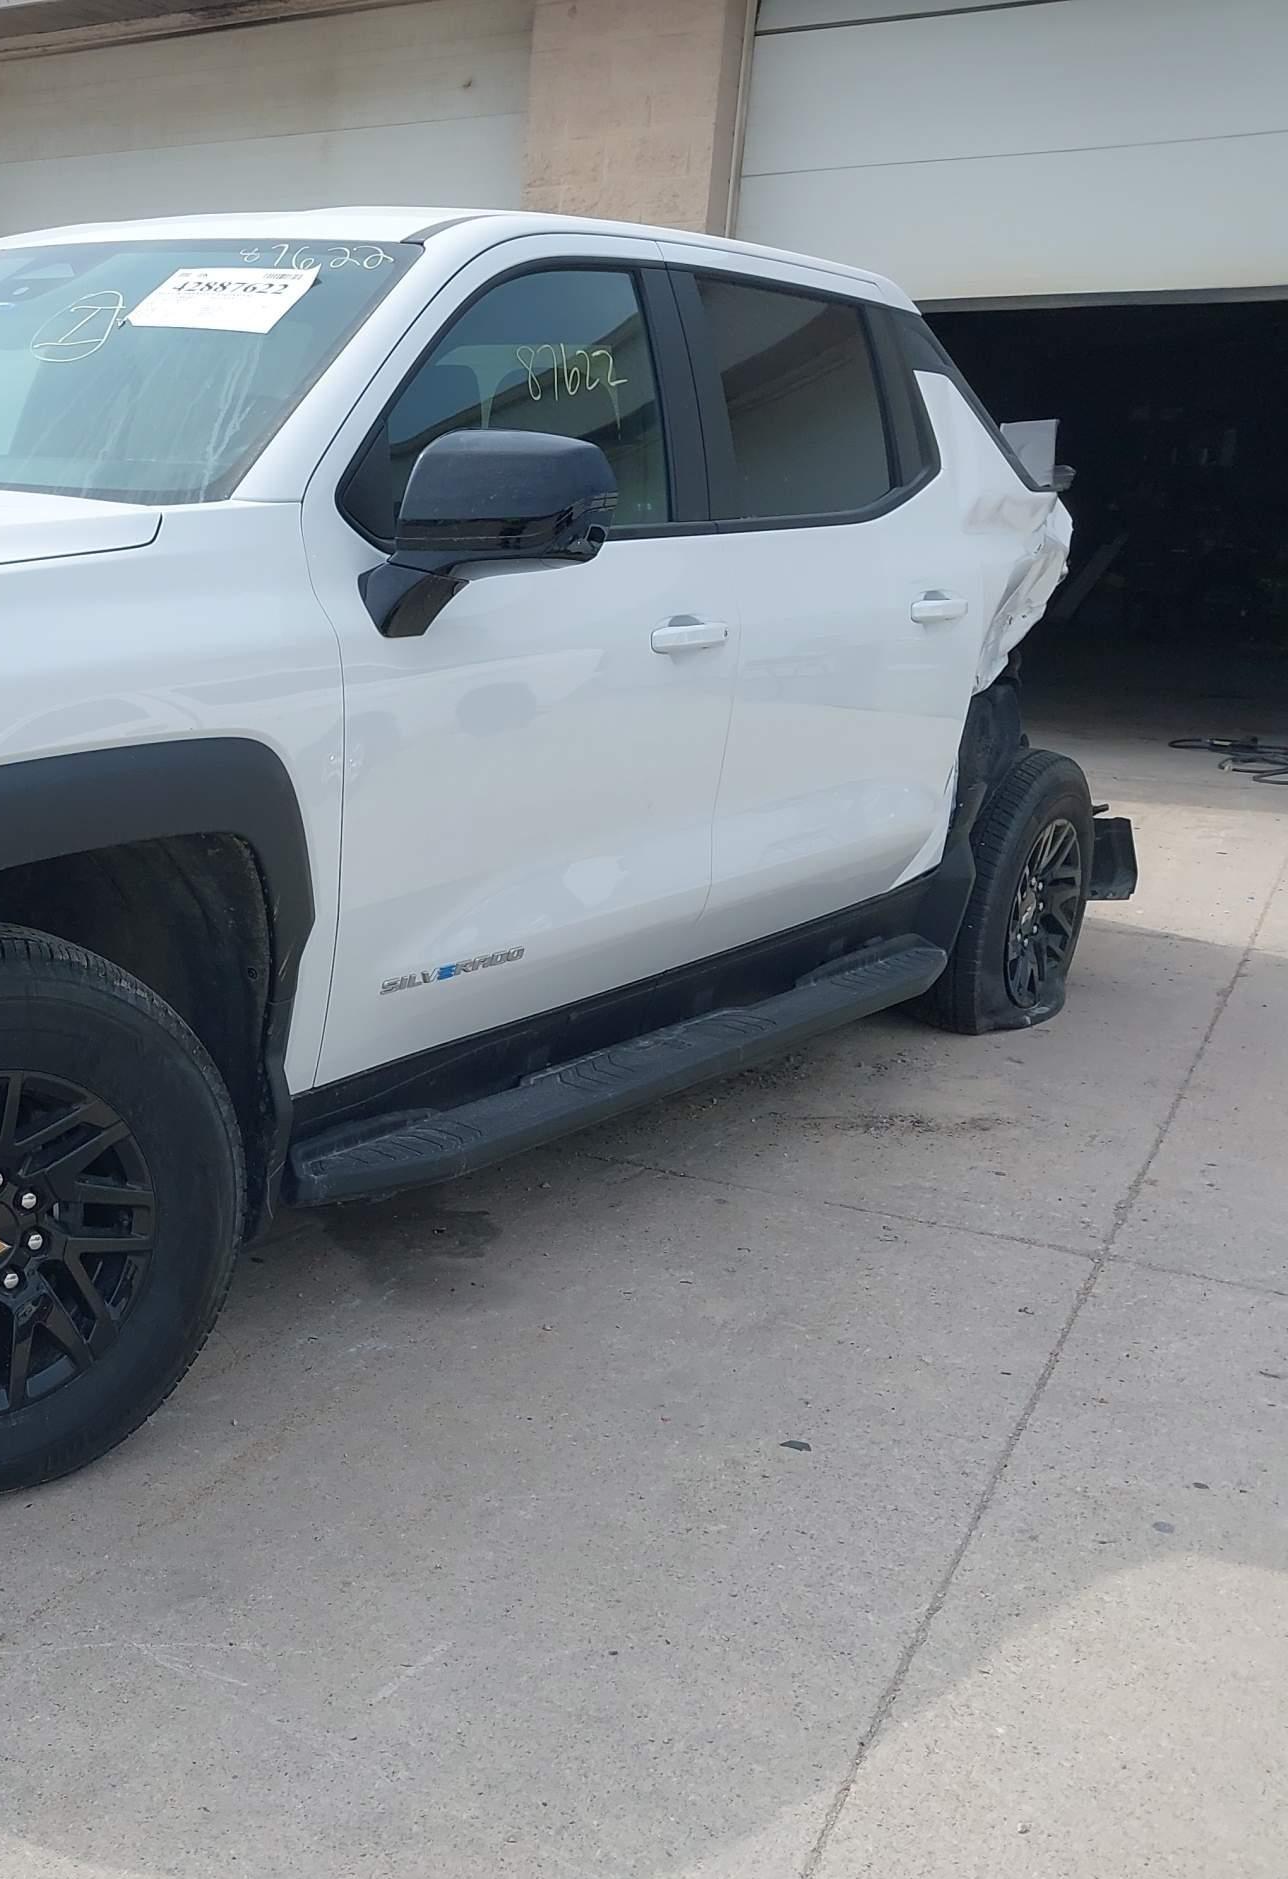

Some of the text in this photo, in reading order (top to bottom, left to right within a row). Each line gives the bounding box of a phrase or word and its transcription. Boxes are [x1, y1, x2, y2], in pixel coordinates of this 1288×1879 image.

[240, 243, 395, 270] 87622
[173, 280, 289, 295] 42887622
[516, 342, 629, 401] 87622
[379, 945, 525, 995] SILVERADO
